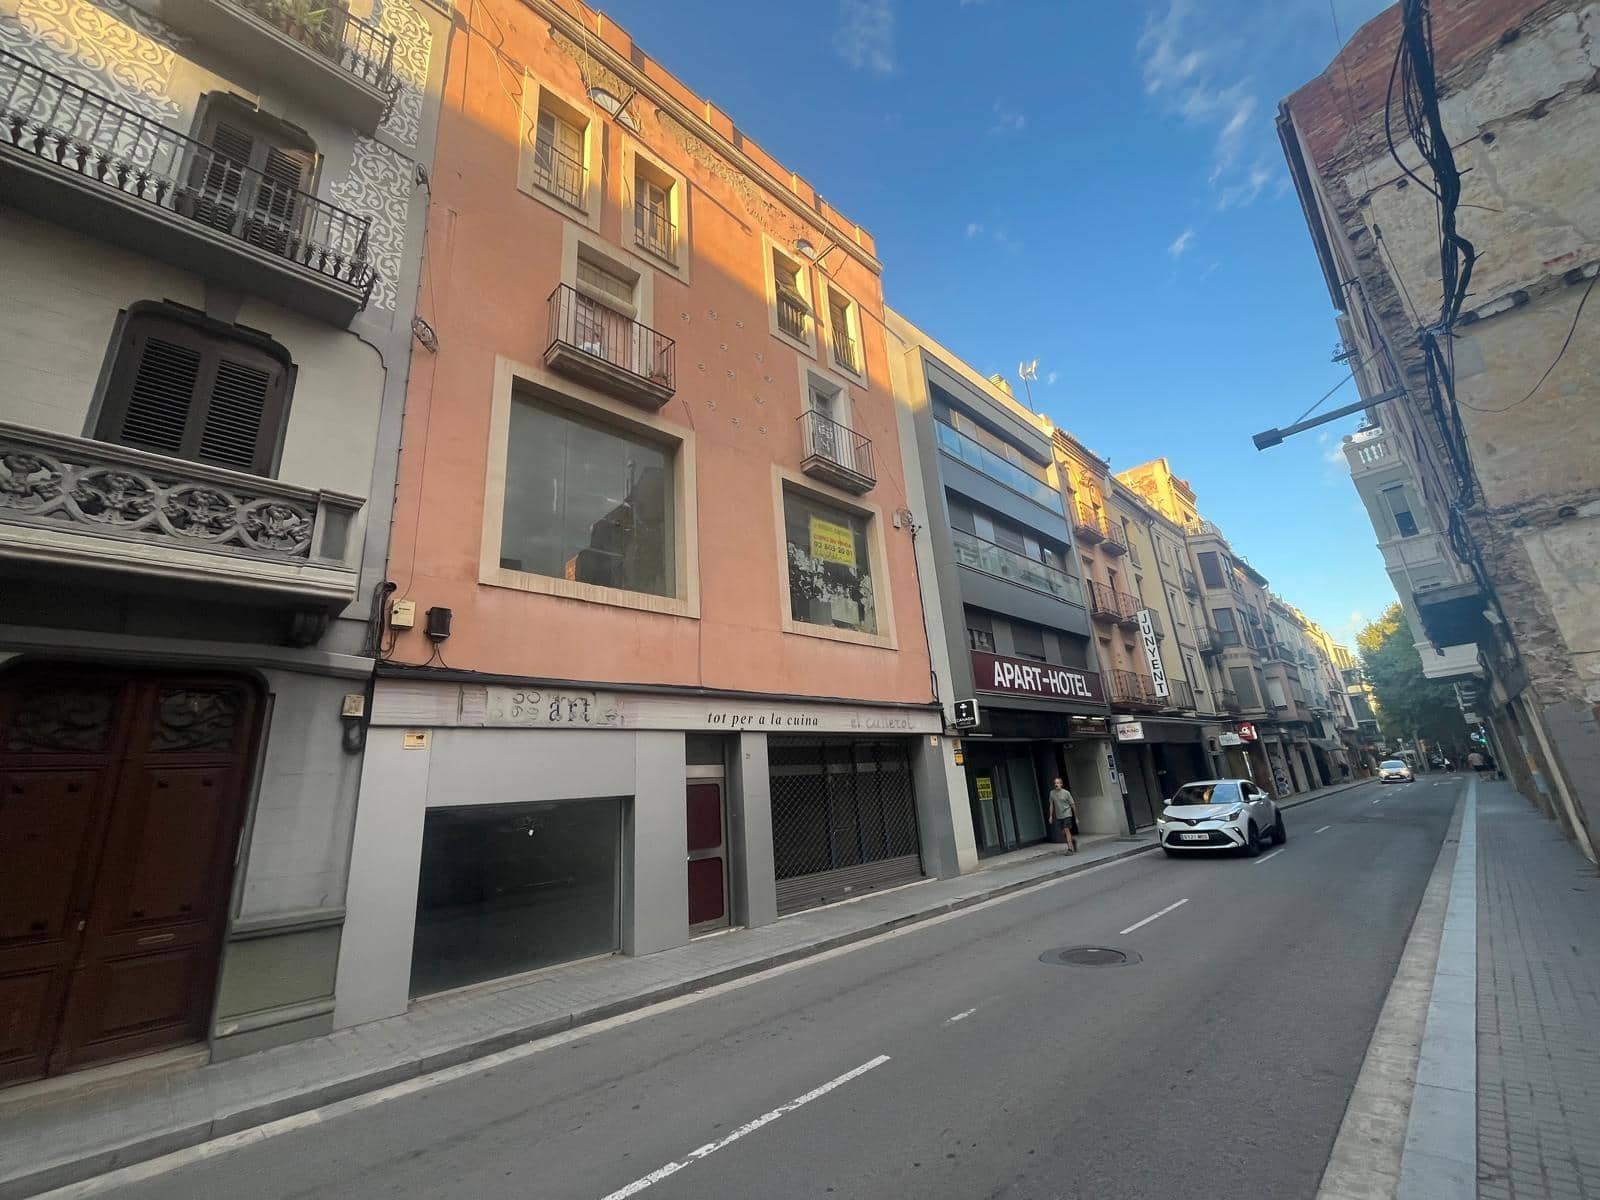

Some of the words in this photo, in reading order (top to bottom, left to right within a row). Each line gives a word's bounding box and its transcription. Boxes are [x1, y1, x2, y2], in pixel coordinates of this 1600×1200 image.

[1141, 613, 1165, 694] JUNYENT
[994, 661, 1092, 697] APART-HOTEL
[707, 712, 727, 724] tot
[731, 713, 754, 728] per
[758, 713, 766, 725] a
[770, 712, 782, 725] la
[787, 714, 819, 726] cuina
